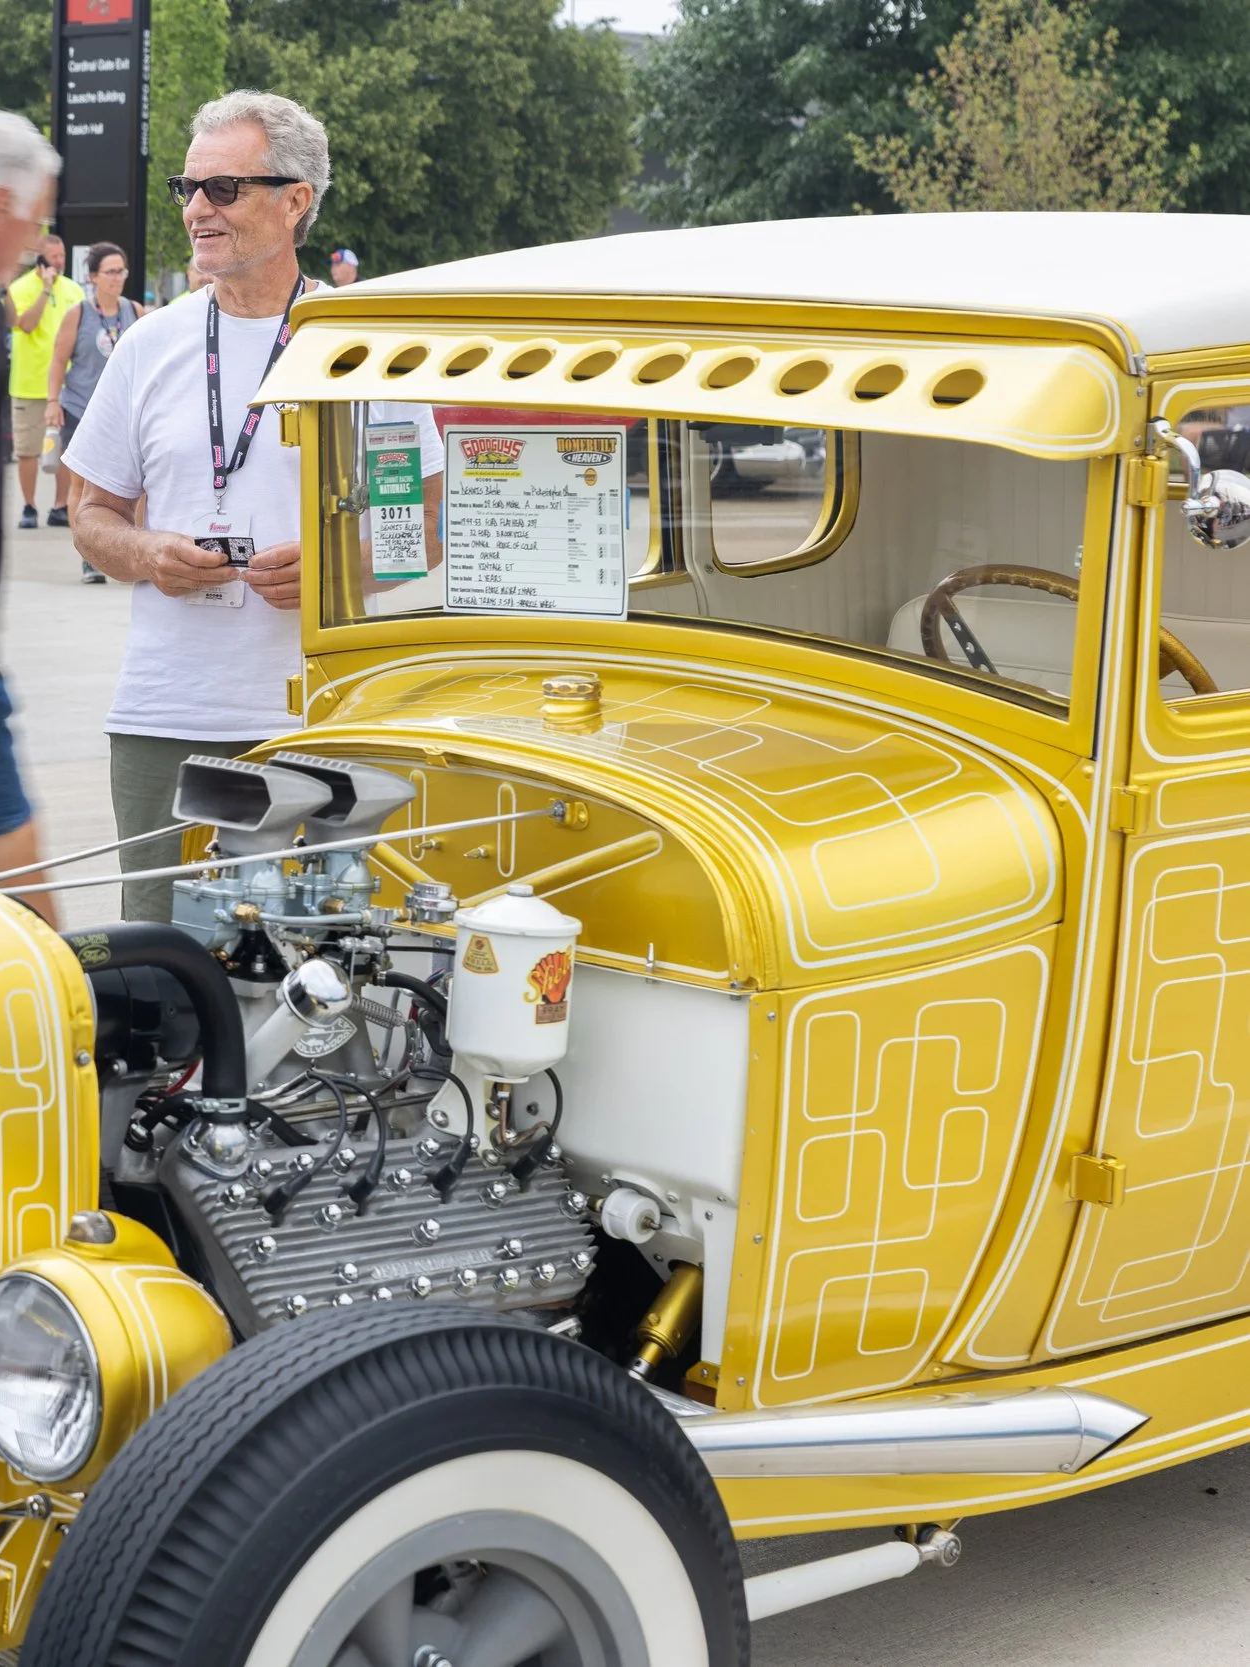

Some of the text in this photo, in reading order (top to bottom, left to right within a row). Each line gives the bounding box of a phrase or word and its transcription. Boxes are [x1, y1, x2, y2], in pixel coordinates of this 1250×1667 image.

[460, 437, 526, 461] GOODGUYS
[557, 438, 617, 453] HOMEBUILT
[571, 453, 602, 463] HEAVEN
[379, 483, 411, 494] NATIONALS
[381, 507, 411, 520] 3071
[523, 945, 572, 1003] Shell
